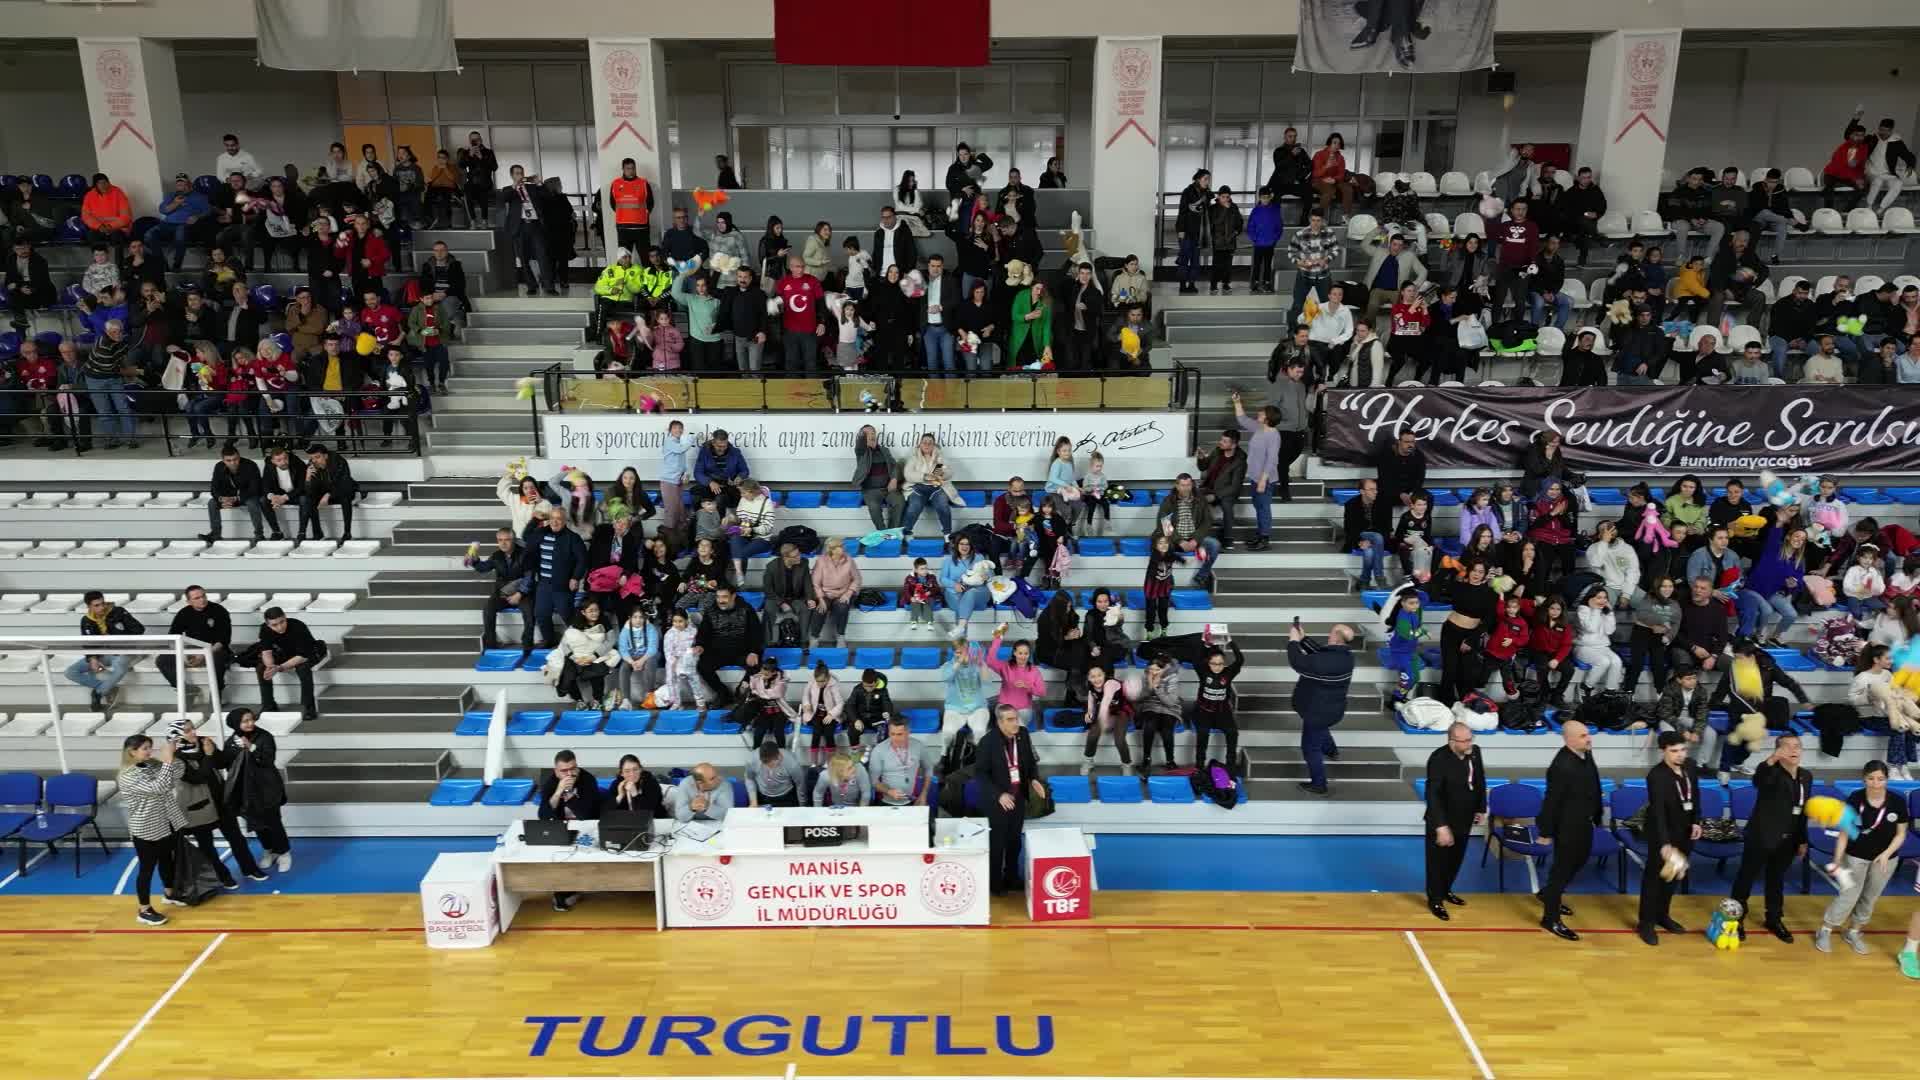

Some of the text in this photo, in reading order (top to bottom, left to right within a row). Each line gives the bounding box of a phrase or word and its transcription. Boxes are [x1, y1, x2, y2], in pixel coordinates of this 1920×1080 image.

[560, 424, 590, 449] Ben
[778, 430, 815, 454] aynı
[821, 423, 895, 448] zamda
[1679, 454, 1813, 468] #unutmayacağız
[804, 826, 841, 838] POSS.
[789, 858, 863, 876] MANİSA
[747, 880, 906, 902] GENÇLİK VE SPOR
[758, 904, 898, 922] İL MÜDÜRLÜĞÜ
[1043, 898, 1081, 915] TBF
[428, 924, 486, 934] BASKETBOL
[523, 1015, 1055, 1057] TURGUTLU
